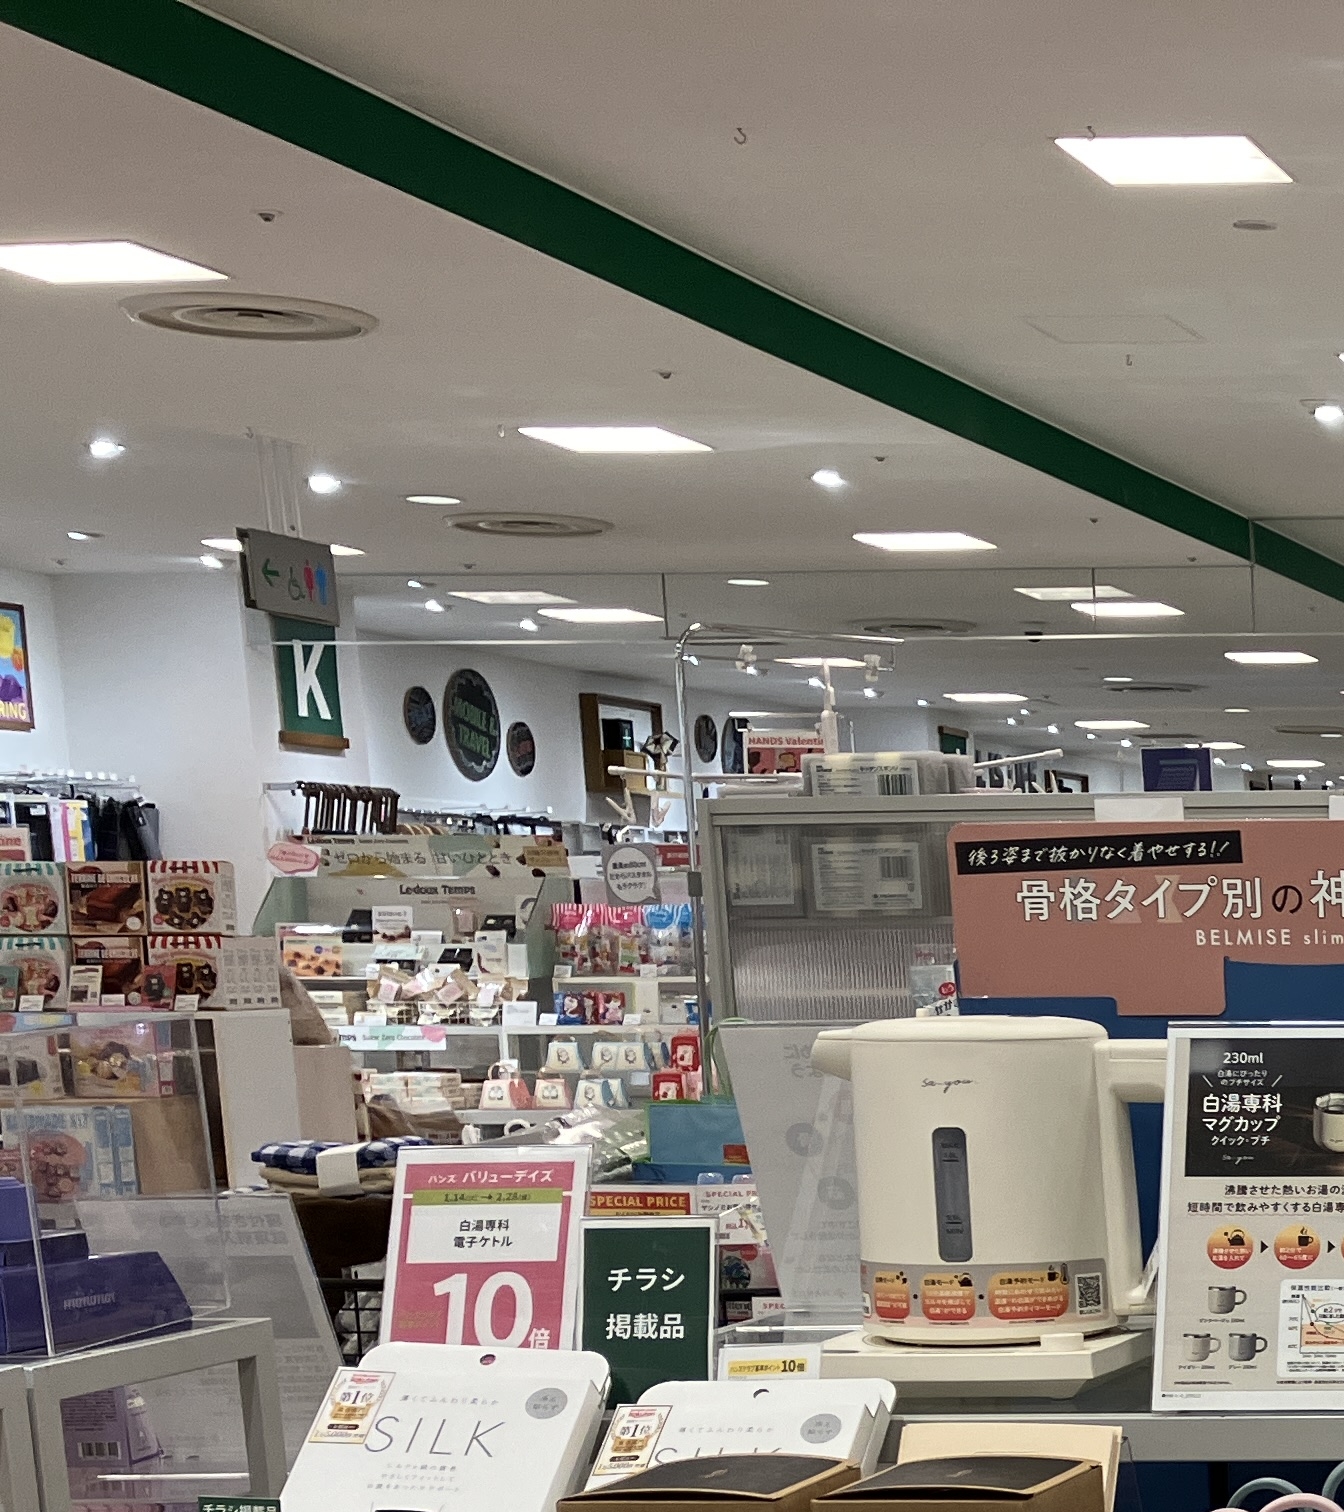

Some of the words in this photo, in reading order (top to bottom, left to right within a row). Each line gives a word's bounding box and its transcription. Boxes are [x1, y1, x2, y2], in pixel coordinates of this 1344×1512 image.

[294, 640, 332, 720] K
[400, 885, 438, 894] Ledoux
[1196, 929, 1290, 946] BELMISE
[1304, 928, 1344, 945] slim
[1223, 1052, 1263, 1064] 230ml
[1202, 1093, 1282, 1112] 白湯専科
[1202, 1116, 1281, 1132] マグカップ
[1211, 1136, 1270, 1145] クイック・プチ
[428, 1175, 457, 1184] ハンズ
[463, 1169, 552, 1184] バリューデイズ
[590, 1196, 657, 1207] SPECIAL
[660, 1197, 686, 1207] PRICE
[460, 1220, 509, 1232] 白湯専科
[453, 1236, 512, 1249] 電子ケトル
[608, 1268, 685, 1291] チラシ
[606, 1314, 684, 1339] 掲載品
[364, 1415, 507, 1458] SILK
